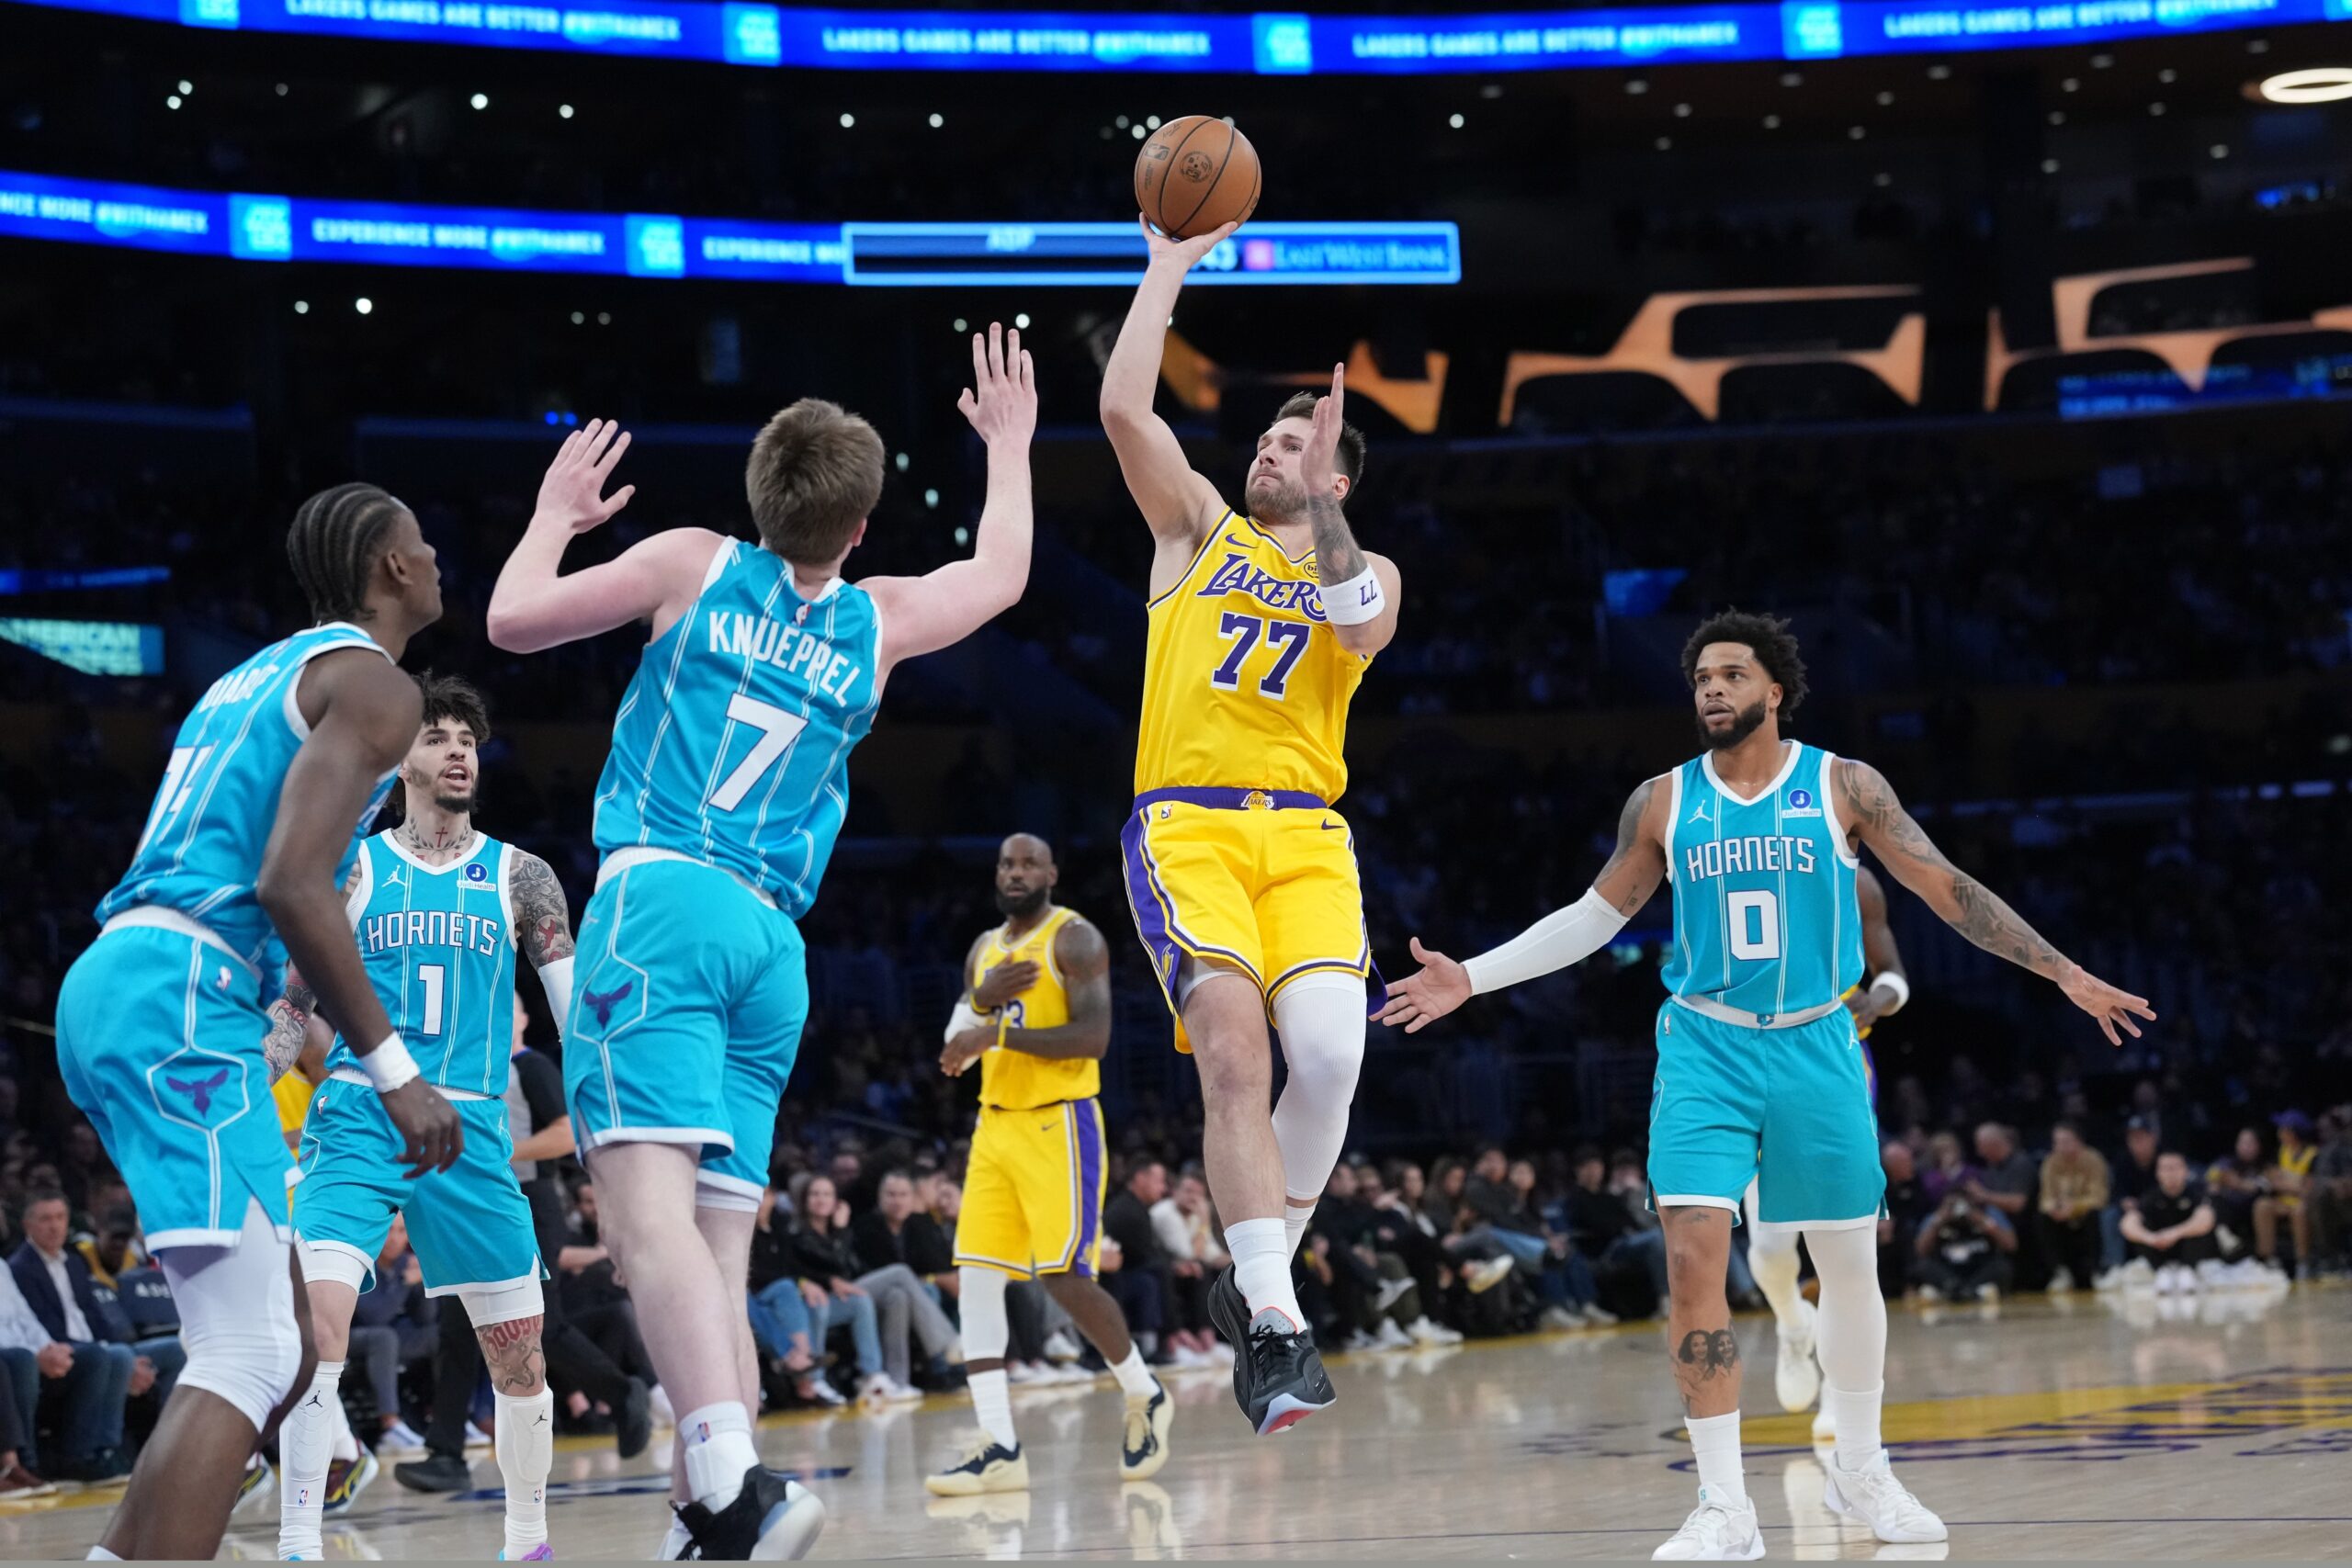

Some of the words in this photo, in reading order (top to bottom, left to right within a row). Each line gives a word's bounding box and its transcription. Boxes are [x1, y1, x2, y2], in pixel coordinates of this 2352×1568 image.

[444, 2, 482, 28] ARE
[486, 5, 560, 32] BETTER
[975, 29, 1012, 54] ARE
[1015, 29, 1091, 55] BETTER
[1502, 29, 1540, 55] ARE
[1543, 26, 1616, 52] BETTER
[2036, 7, 2075, 30] ARE
[1196, 552, 1329, 623] LAKERS
[708, 610, 861, 708] KNUEPPEL
[1211, 611, 1312, 702] 77
[707, 691, 810, 813] 7
[1685, 835, 1818, 884] HORNETS
[368, 910, 499, 958] HORNETS
[1726, 889, 1781, 962] 0
[418, 964, 446, 1036] 1
